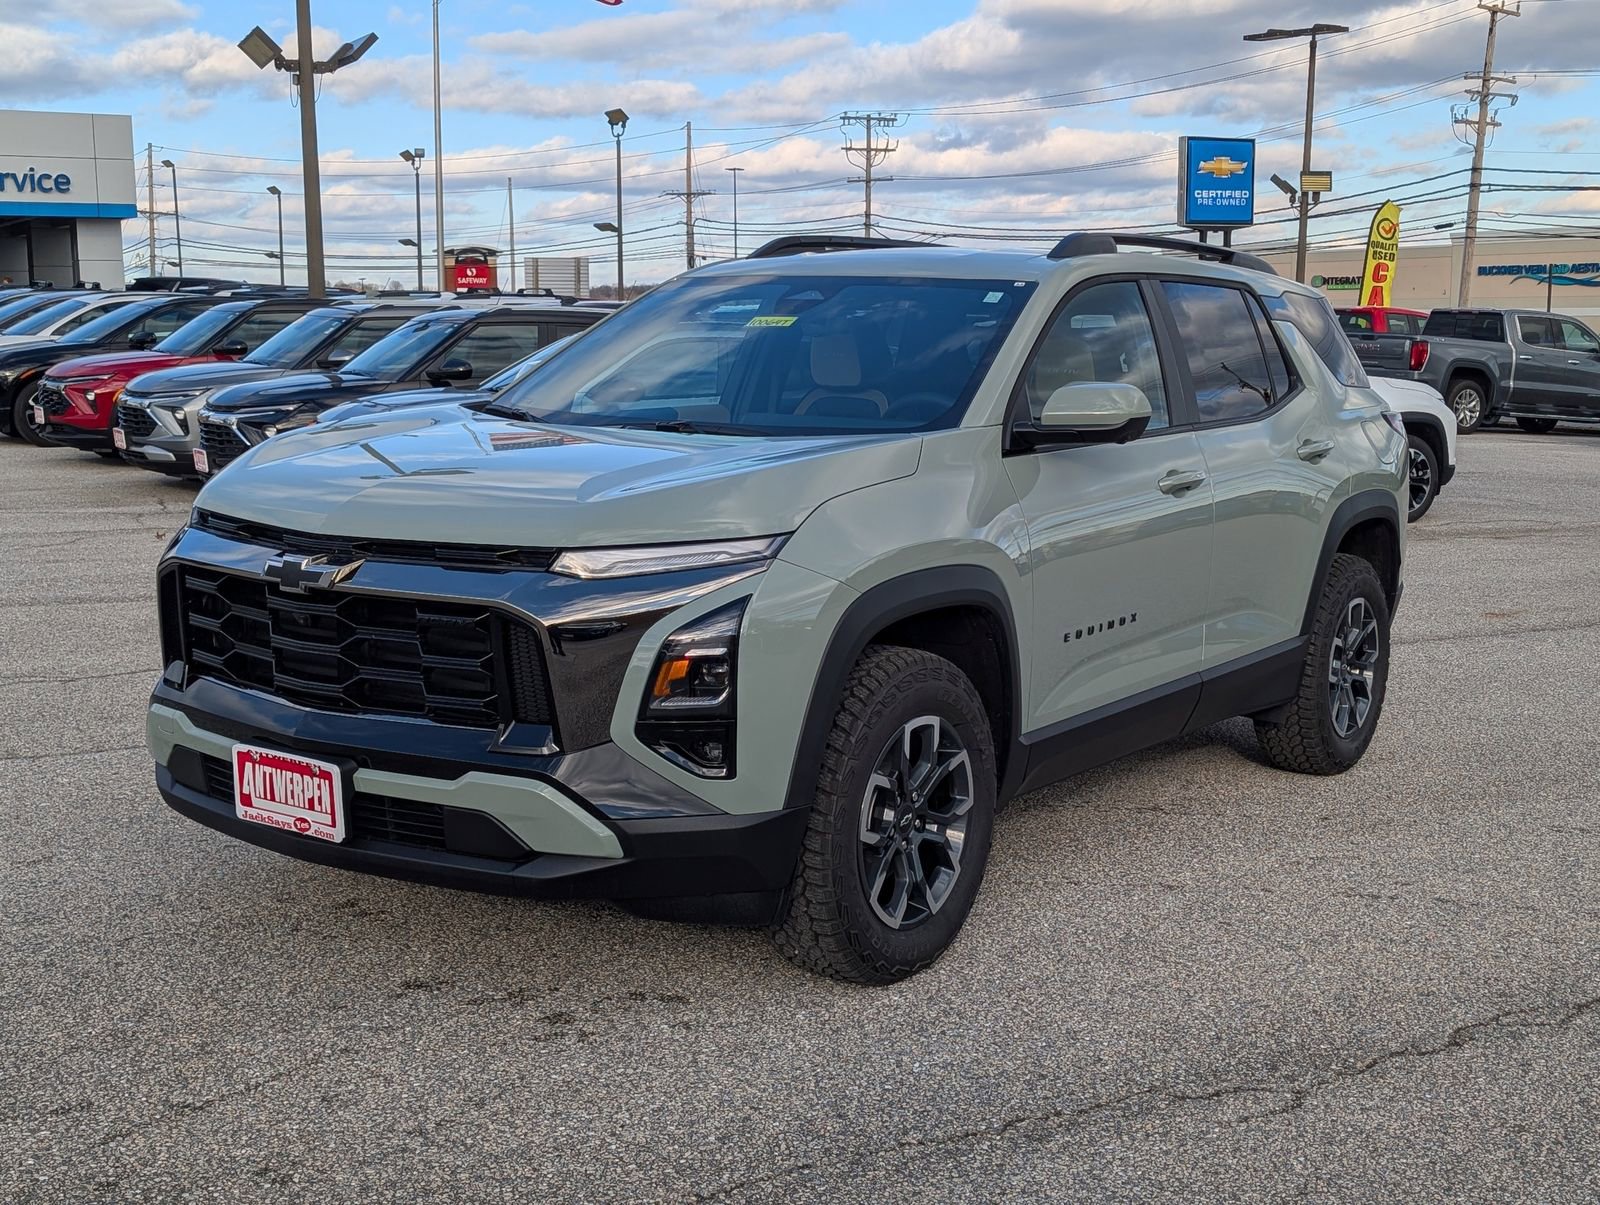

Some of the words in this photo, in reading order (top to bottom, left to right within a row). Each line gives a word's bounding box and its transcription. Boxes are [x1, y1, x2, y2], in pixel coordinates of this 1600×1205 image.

[1194, 190, 1250, 198] CERTIFIED
[1372, 250, 1396, 262] USED
[1478, 264, 1523, 276] BUCKNER
[1523, 264, 1548, 275] VEIN
[1063, 612, 1137, 643] EQUINOX
[242, 761, 331, 814] ANTWERPEN
